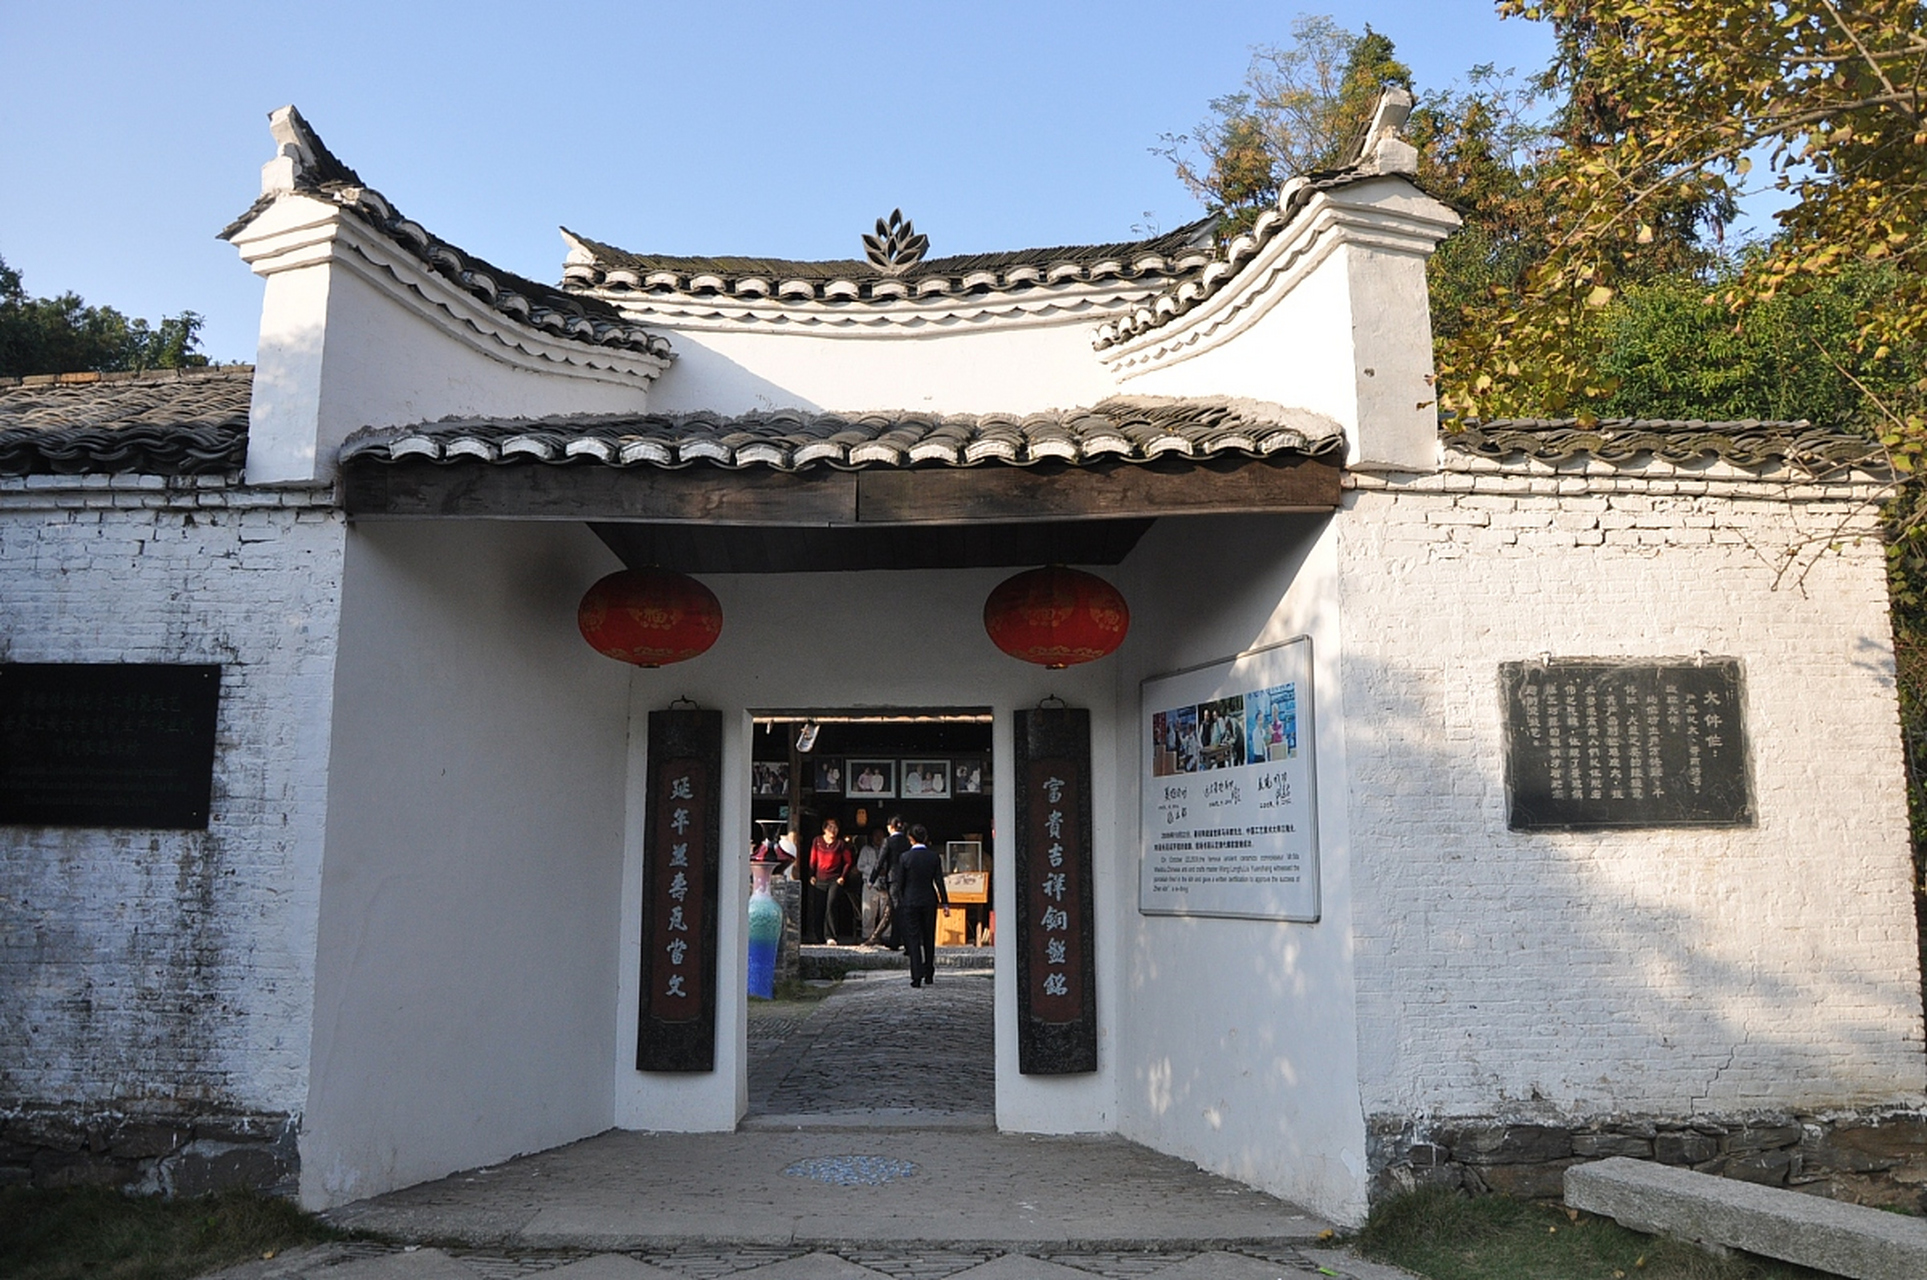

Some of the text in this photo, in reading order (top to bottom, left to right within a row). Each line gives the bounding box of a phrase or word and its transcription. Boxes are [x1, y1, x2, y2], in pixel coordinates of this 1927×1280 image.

[1041, 777, 1068, 996] 富貴吉祥銅盤銘
